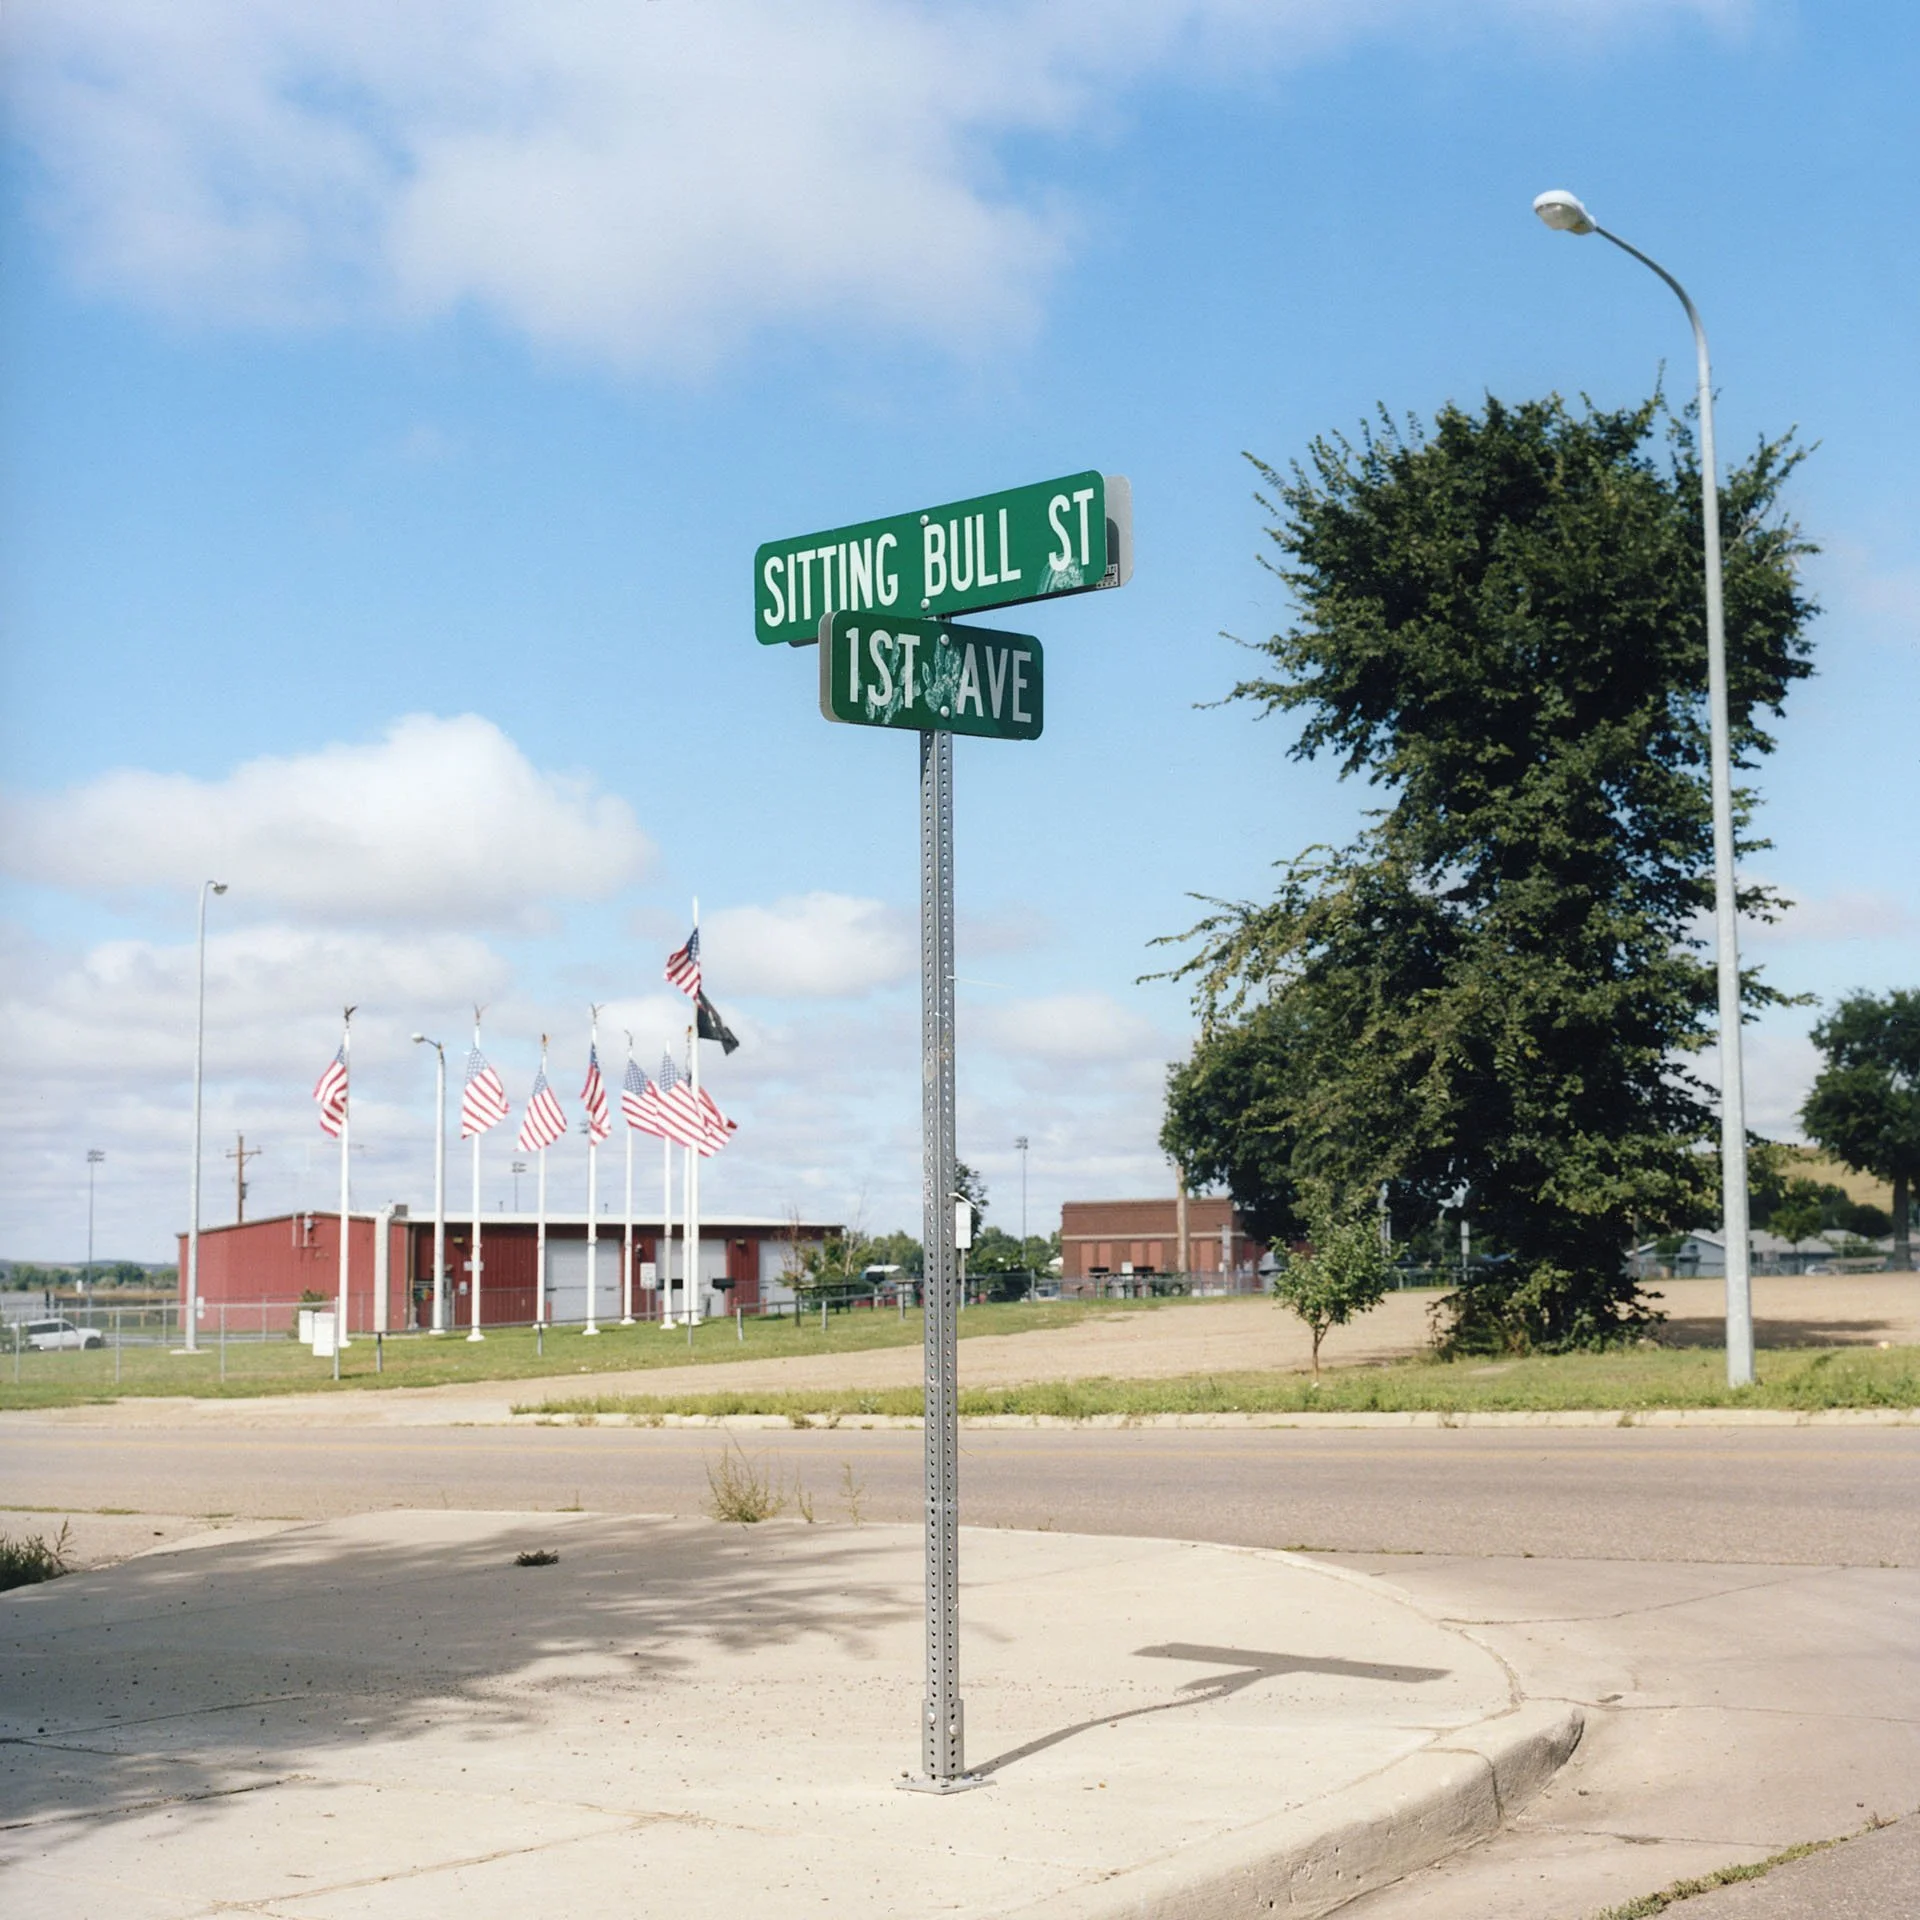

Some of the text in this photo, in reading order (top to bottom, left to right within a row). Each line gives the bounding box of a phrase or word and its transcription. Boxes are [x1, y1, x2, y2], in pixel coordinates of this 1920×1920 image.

[763, 487, 1094, 627] SITTING BULL ST
[845, 627, 1032, 723] 1ST AVE
